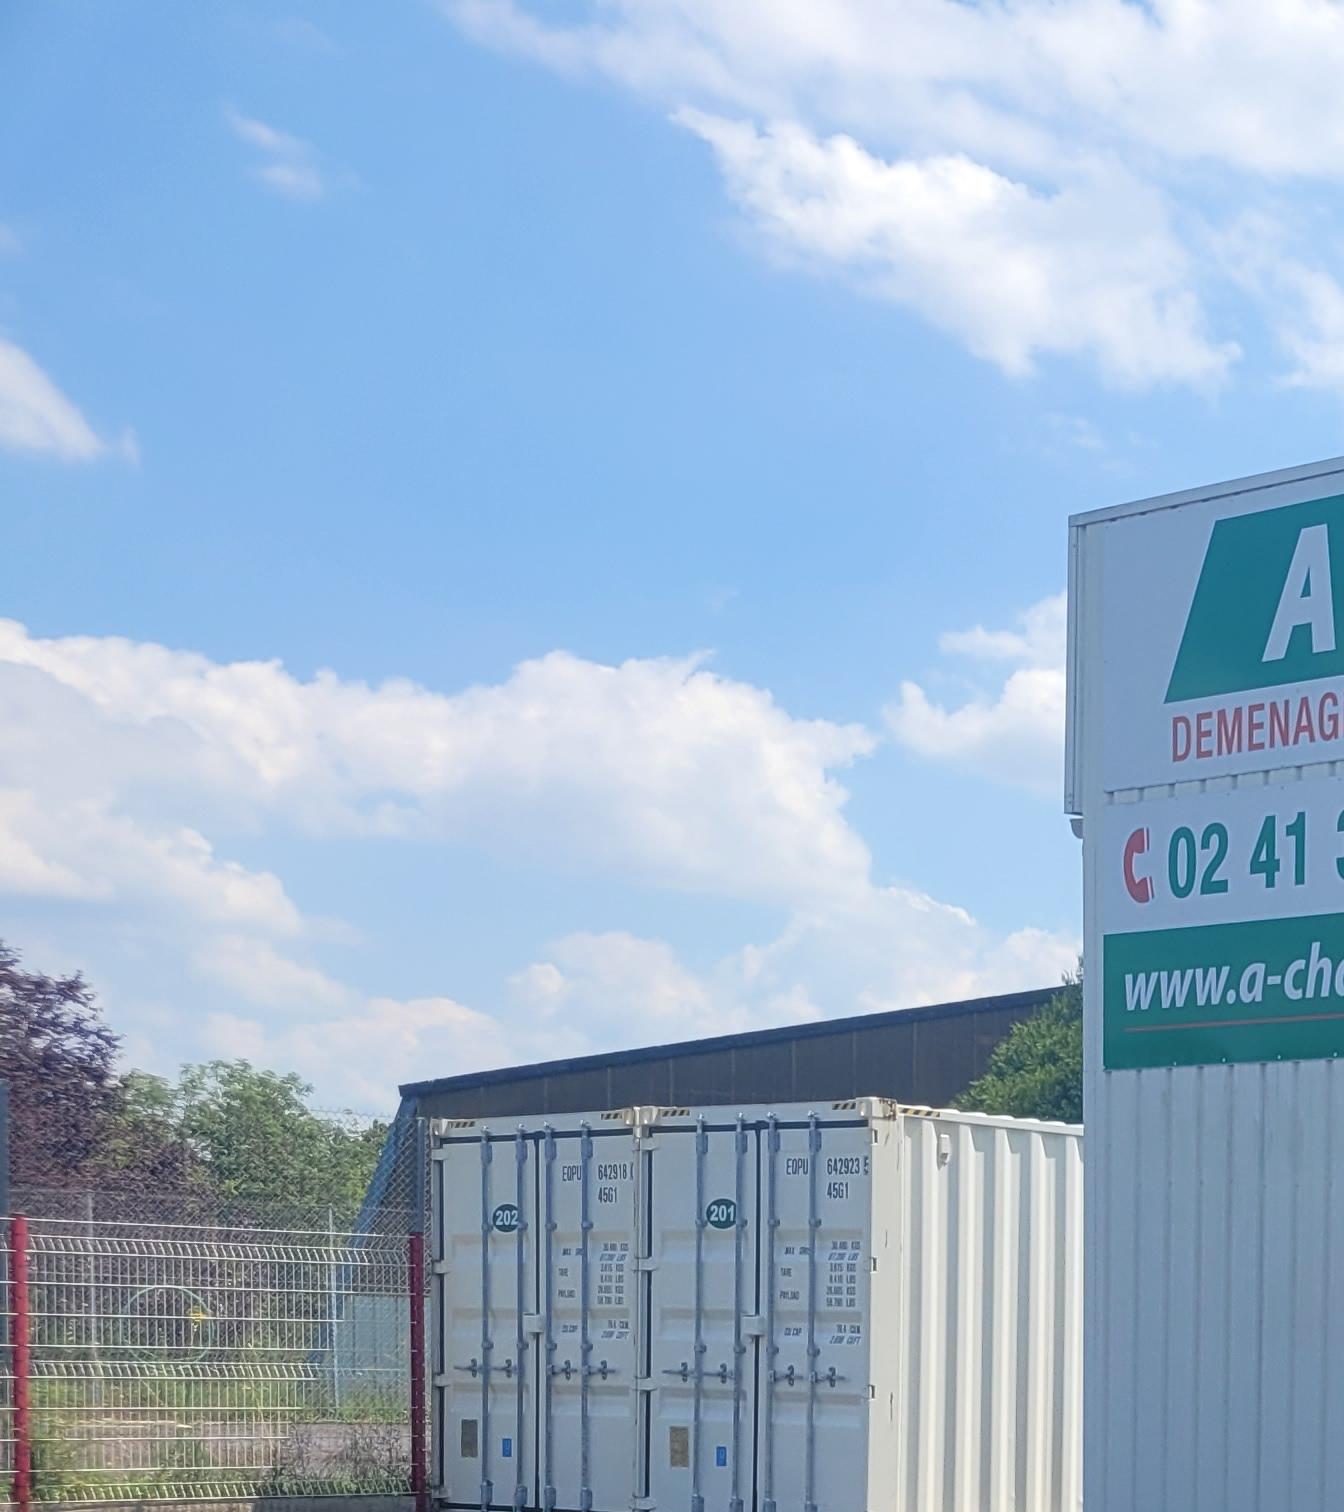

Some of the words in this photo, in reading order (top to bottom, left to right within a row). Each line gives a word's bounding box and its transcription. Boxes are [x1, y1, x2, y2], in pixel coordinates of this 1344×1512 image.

[1167, 822, 1229, 900] 02
[1248, 811, 1307, 889] 41
[597, 1163, 628, 1180] 642918
[826, 1157, 860, 1175] 642923
[597, 1187, 618, 1203] 45G1
[826, 1182, 849, 1199] 45G1
[495, 1210, 519, 1226] 202
[709, 1204, 735, 1222] 201
